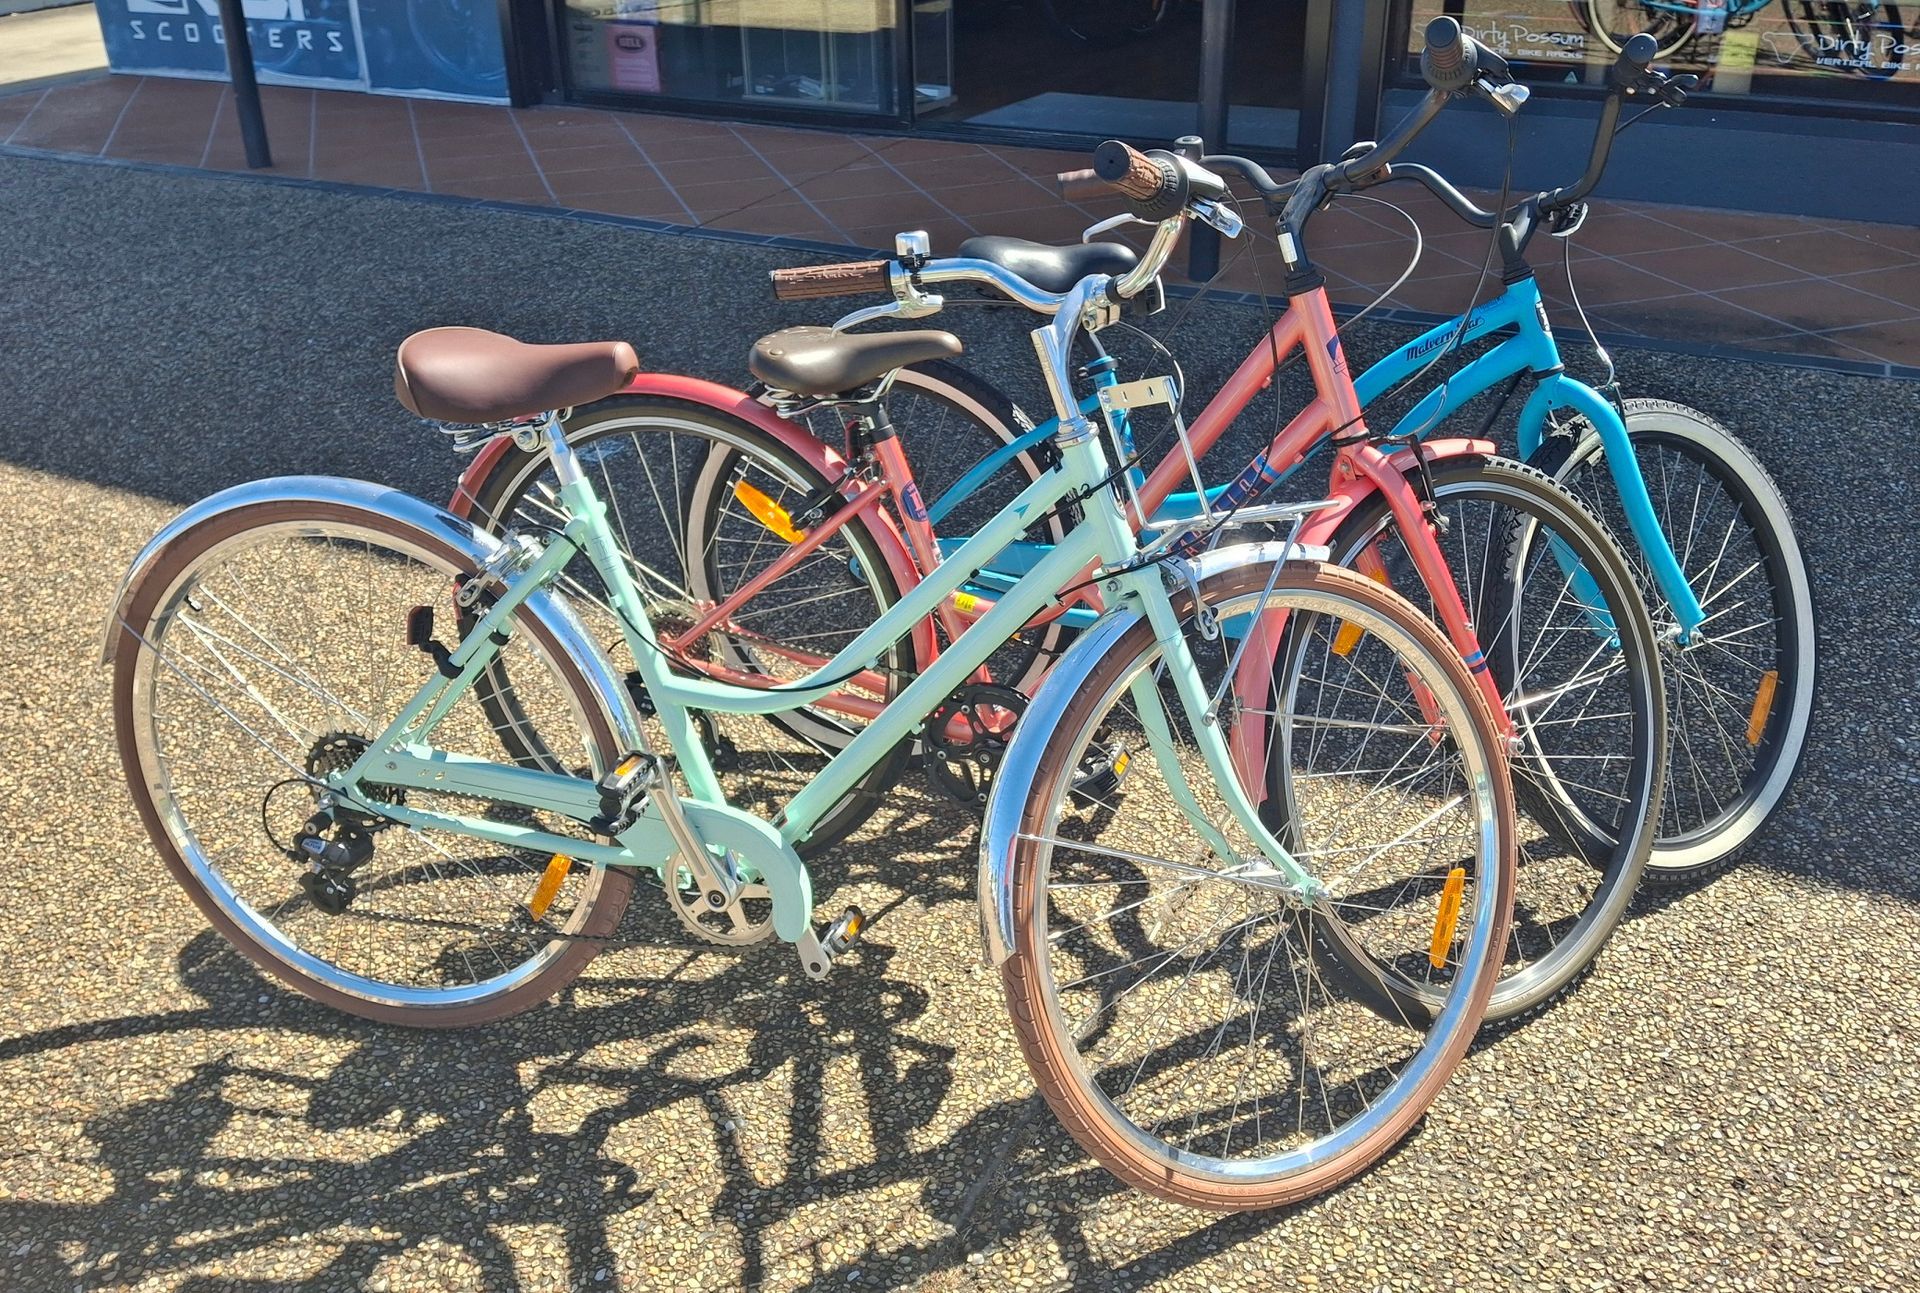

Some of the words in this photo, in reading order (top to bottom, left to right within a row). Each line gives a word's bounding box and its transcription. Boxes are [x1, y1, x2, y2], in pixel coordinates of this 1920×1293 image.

[129, 20, 344, 52] SCOOERS
[1509, 24, 1584, 48] Possum
[1818, 30, 1875, 60] Dirty
[1816, 57, 1877, 68] VERTICAL
[1881, 61, 1911, 70] BIKE
[1404, 330, 1454, 361] Malvern
